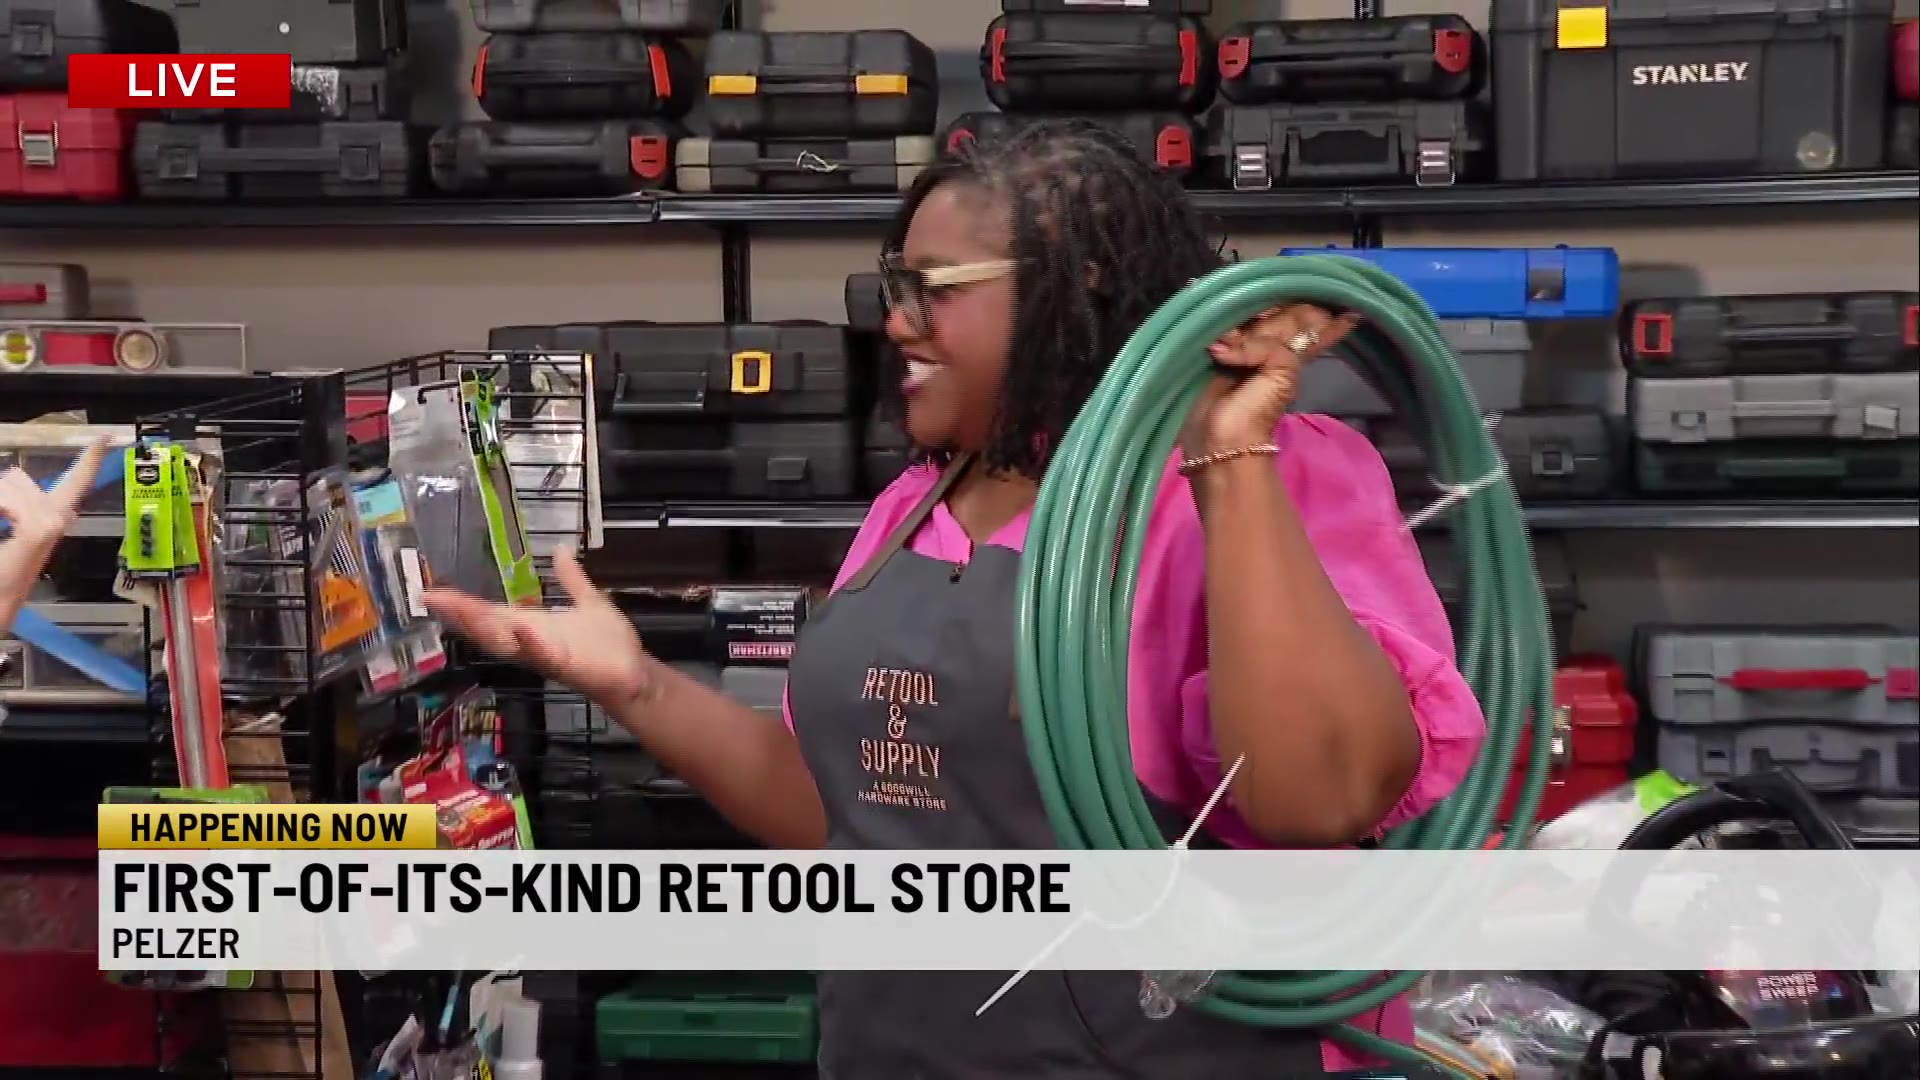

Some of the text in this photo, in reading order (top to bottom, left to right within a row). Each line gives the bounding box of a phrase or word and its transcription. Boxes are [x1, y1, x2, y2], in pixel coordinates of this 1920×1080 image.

[1632, 62, 1749, 85] STANLEY
[861, 667, 939, 706] RETOOL
[887, 703, 907, 739] &
[860, 737, 940, 779] SUPPLY
[880, 781, 930, 797] GOODWILL
[857, 790, 948, 811] HARDWARE STORE
[1756, 973, 1818, 988] POWER
[1759, 986, 1820, 1000] SWEEP
